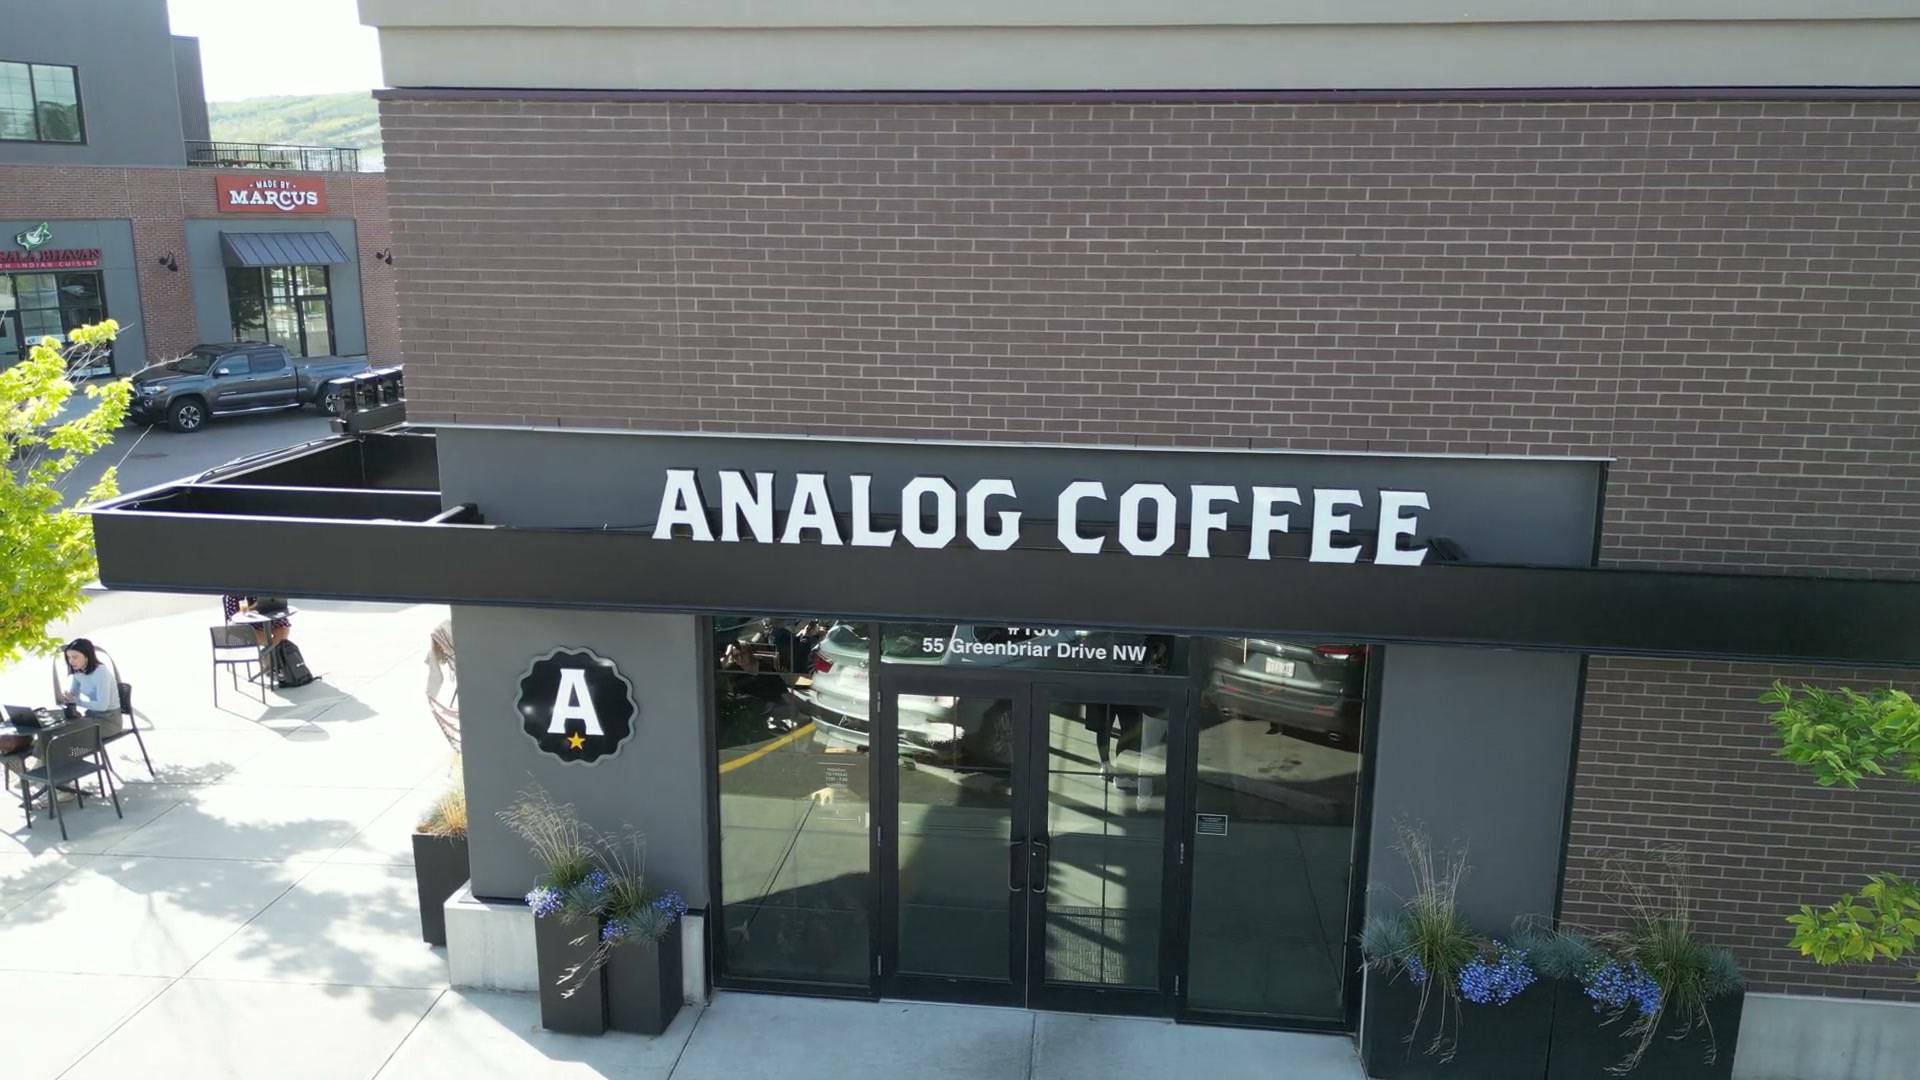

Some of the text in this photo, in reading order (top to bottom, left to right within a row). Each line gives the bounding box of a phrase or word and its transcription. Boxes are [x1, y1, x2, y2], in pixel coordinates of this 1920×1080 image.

[256, 180, 290, 189] MADE BY
[229, 190, 318, 210] MARCUS
[41, 249, 102, 260] BHAVAN
[652, 469, 1431, 566] ANALOG COFFEE
[922, 637, 1147, 662] 55 Greenbriar Drive NW
[547, 668, 604, 735] A
